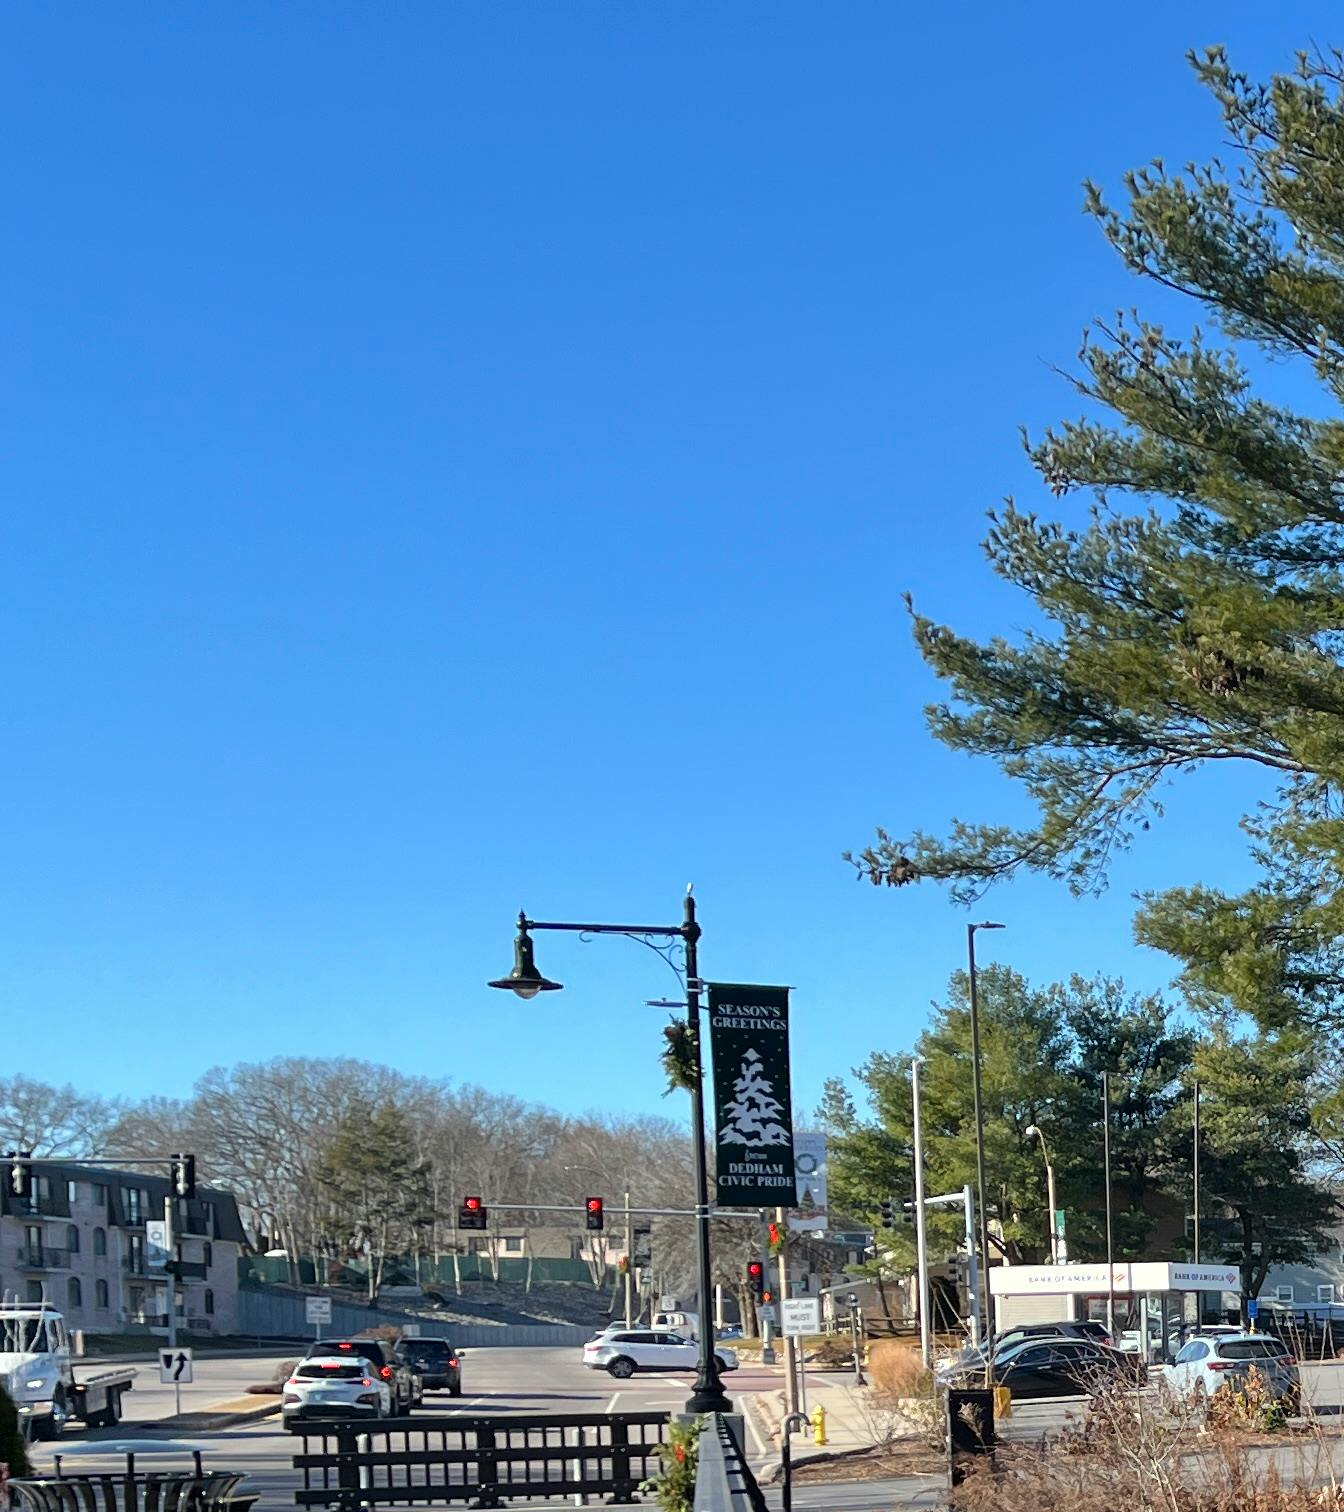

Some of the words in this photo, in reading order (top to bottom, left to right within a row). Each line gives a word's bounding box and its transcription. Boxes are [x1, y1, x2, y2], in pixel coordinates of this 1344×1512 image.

[718, 1003, 781, 1017] SEASON'S
[712, 1016, 787, 1030] GREETINGS
[728, 1162, 784, 1175] DEDHAM
[718, 1175, 755, 1187] CIVIC
[757, 1176, 794, 1187] PRIDE
[1028, 1276, 1052, 1284] BANK
[1054, 1275, 1065, 1283] OF
[1174, 1272, 1190, 1280] BANK
[790, 1312, 810, 1321] MUST
